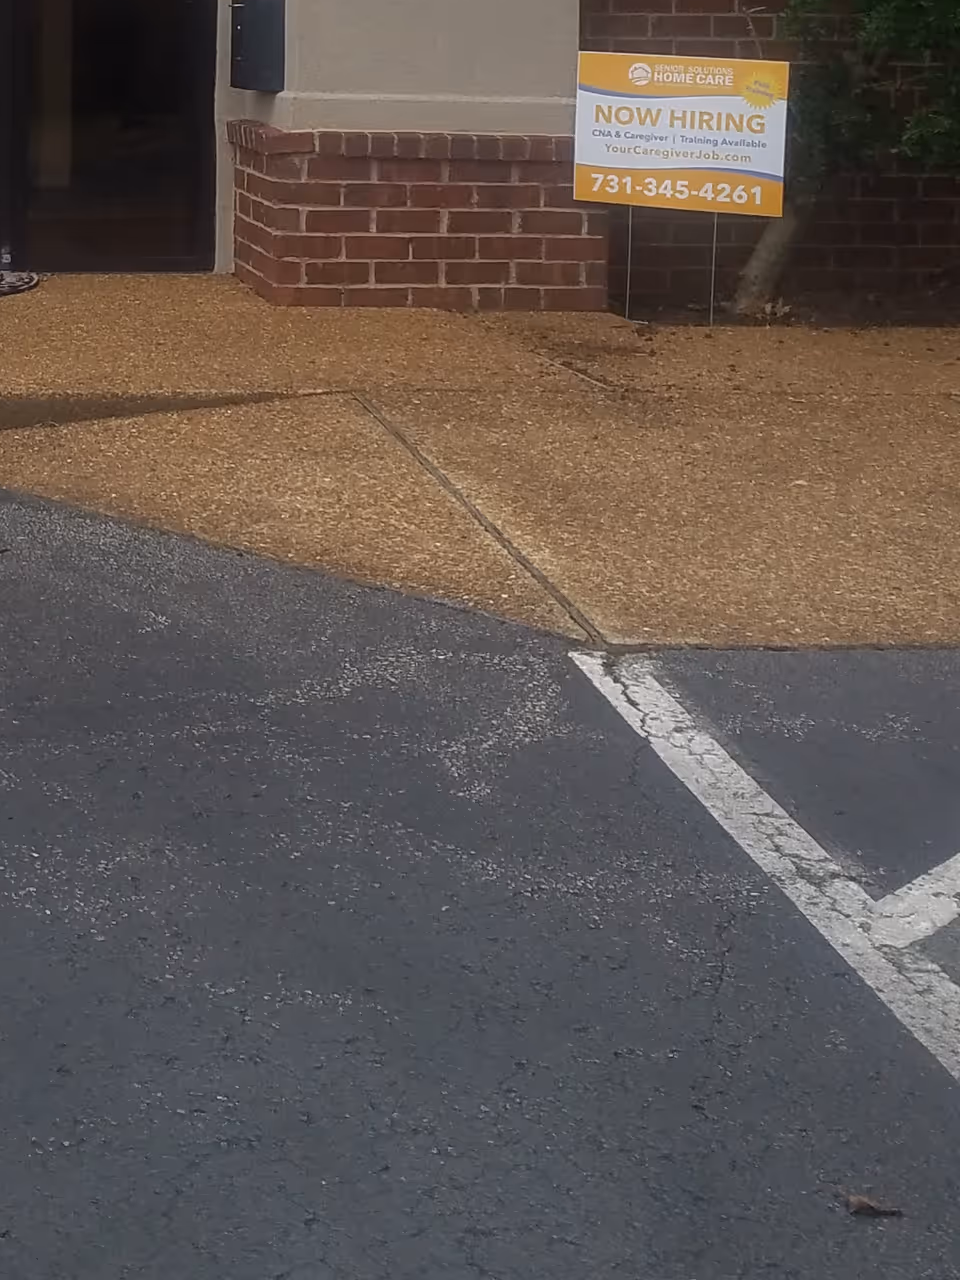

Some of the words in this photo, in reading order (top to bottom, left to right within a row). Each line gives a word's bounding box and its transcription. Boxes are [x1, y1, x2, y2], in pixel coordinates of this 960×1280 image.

[653, 72, 694, 84] HOME
[696, 74, 734, 86] CARE
[687, 66, 734, 76] SOLUTIONS
[594, 104, 662, 127] NOW
[669, 109, 766, 135] HIRING
[592, 128, 613, 138] CNA
[614, 130, 621, 139] &
[624, 131, 668, 142] Caregiver
[679, 135, 719, 147] Training
[720, 137, 768, 149] Available
[605, 143, 752, 163] YourCaregiverJob.com
[591, 173, 763, 205] 731-345-4261
